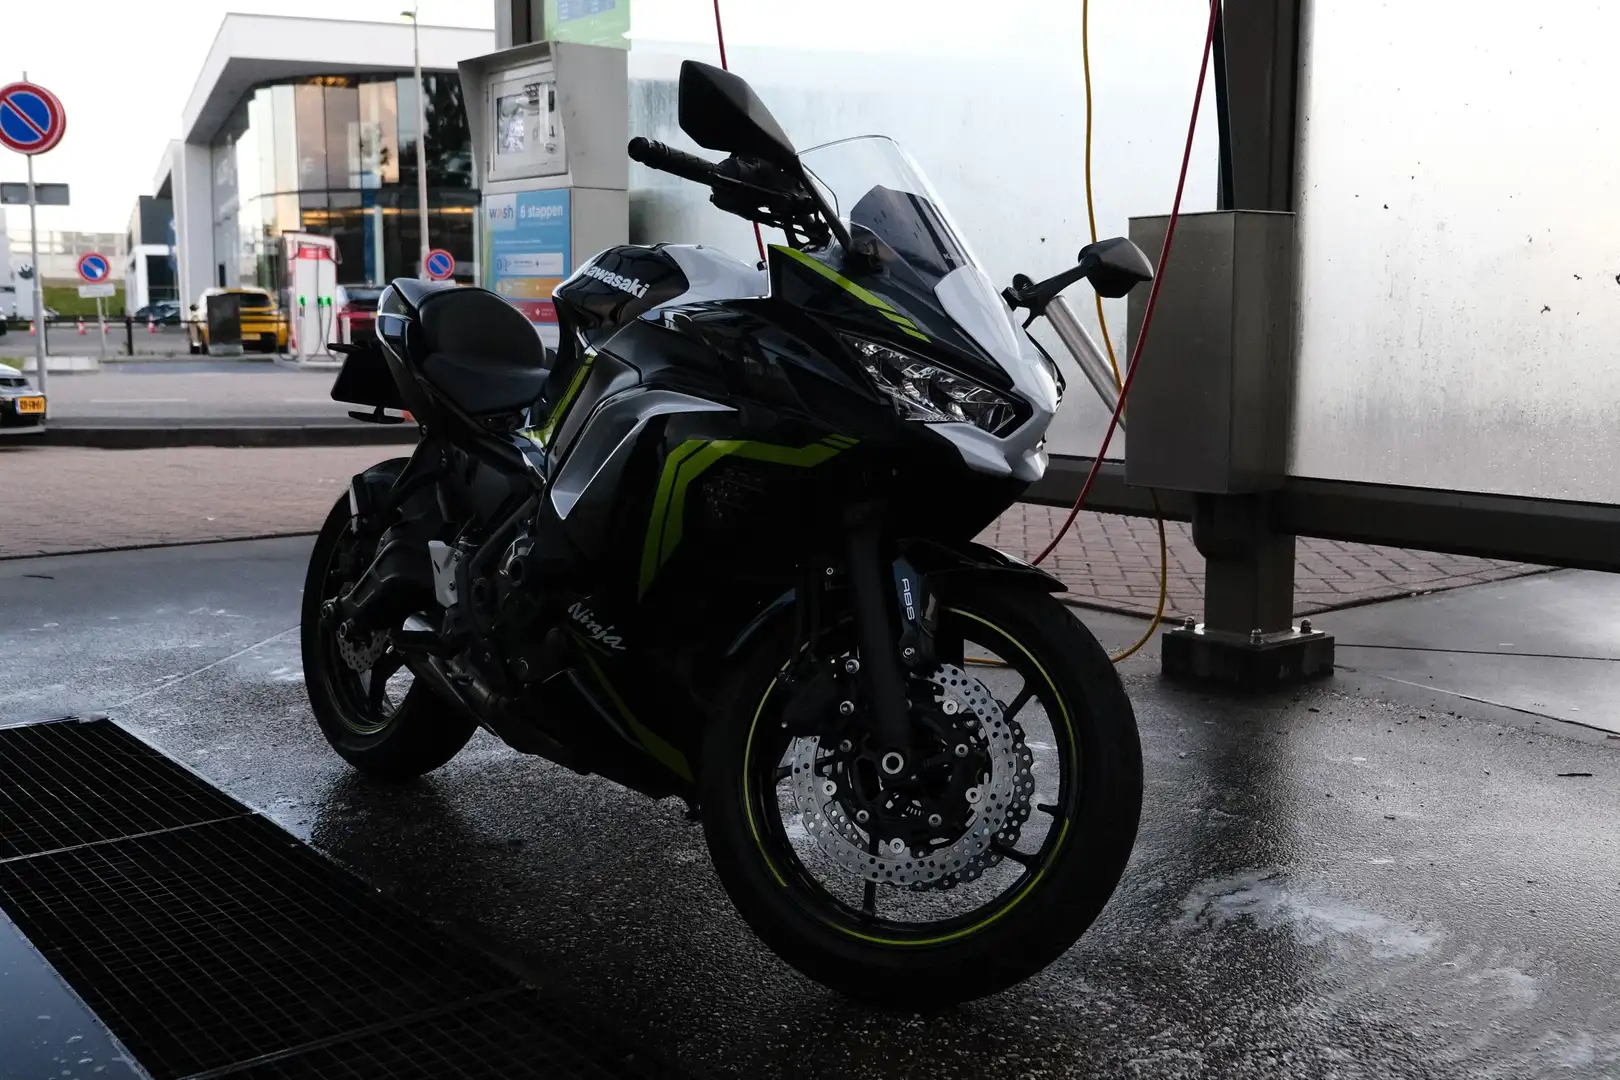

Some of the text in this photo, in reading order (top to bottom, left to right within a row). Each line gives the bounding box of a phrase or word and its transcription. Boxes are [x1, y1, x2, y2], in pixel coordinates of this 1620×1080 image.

[489, 204, 514, 220] wash
[527, 205, 563, 220] stappen
[902, 578, 915, 621] ABS
[567, 601, 626, 650] Ninja
